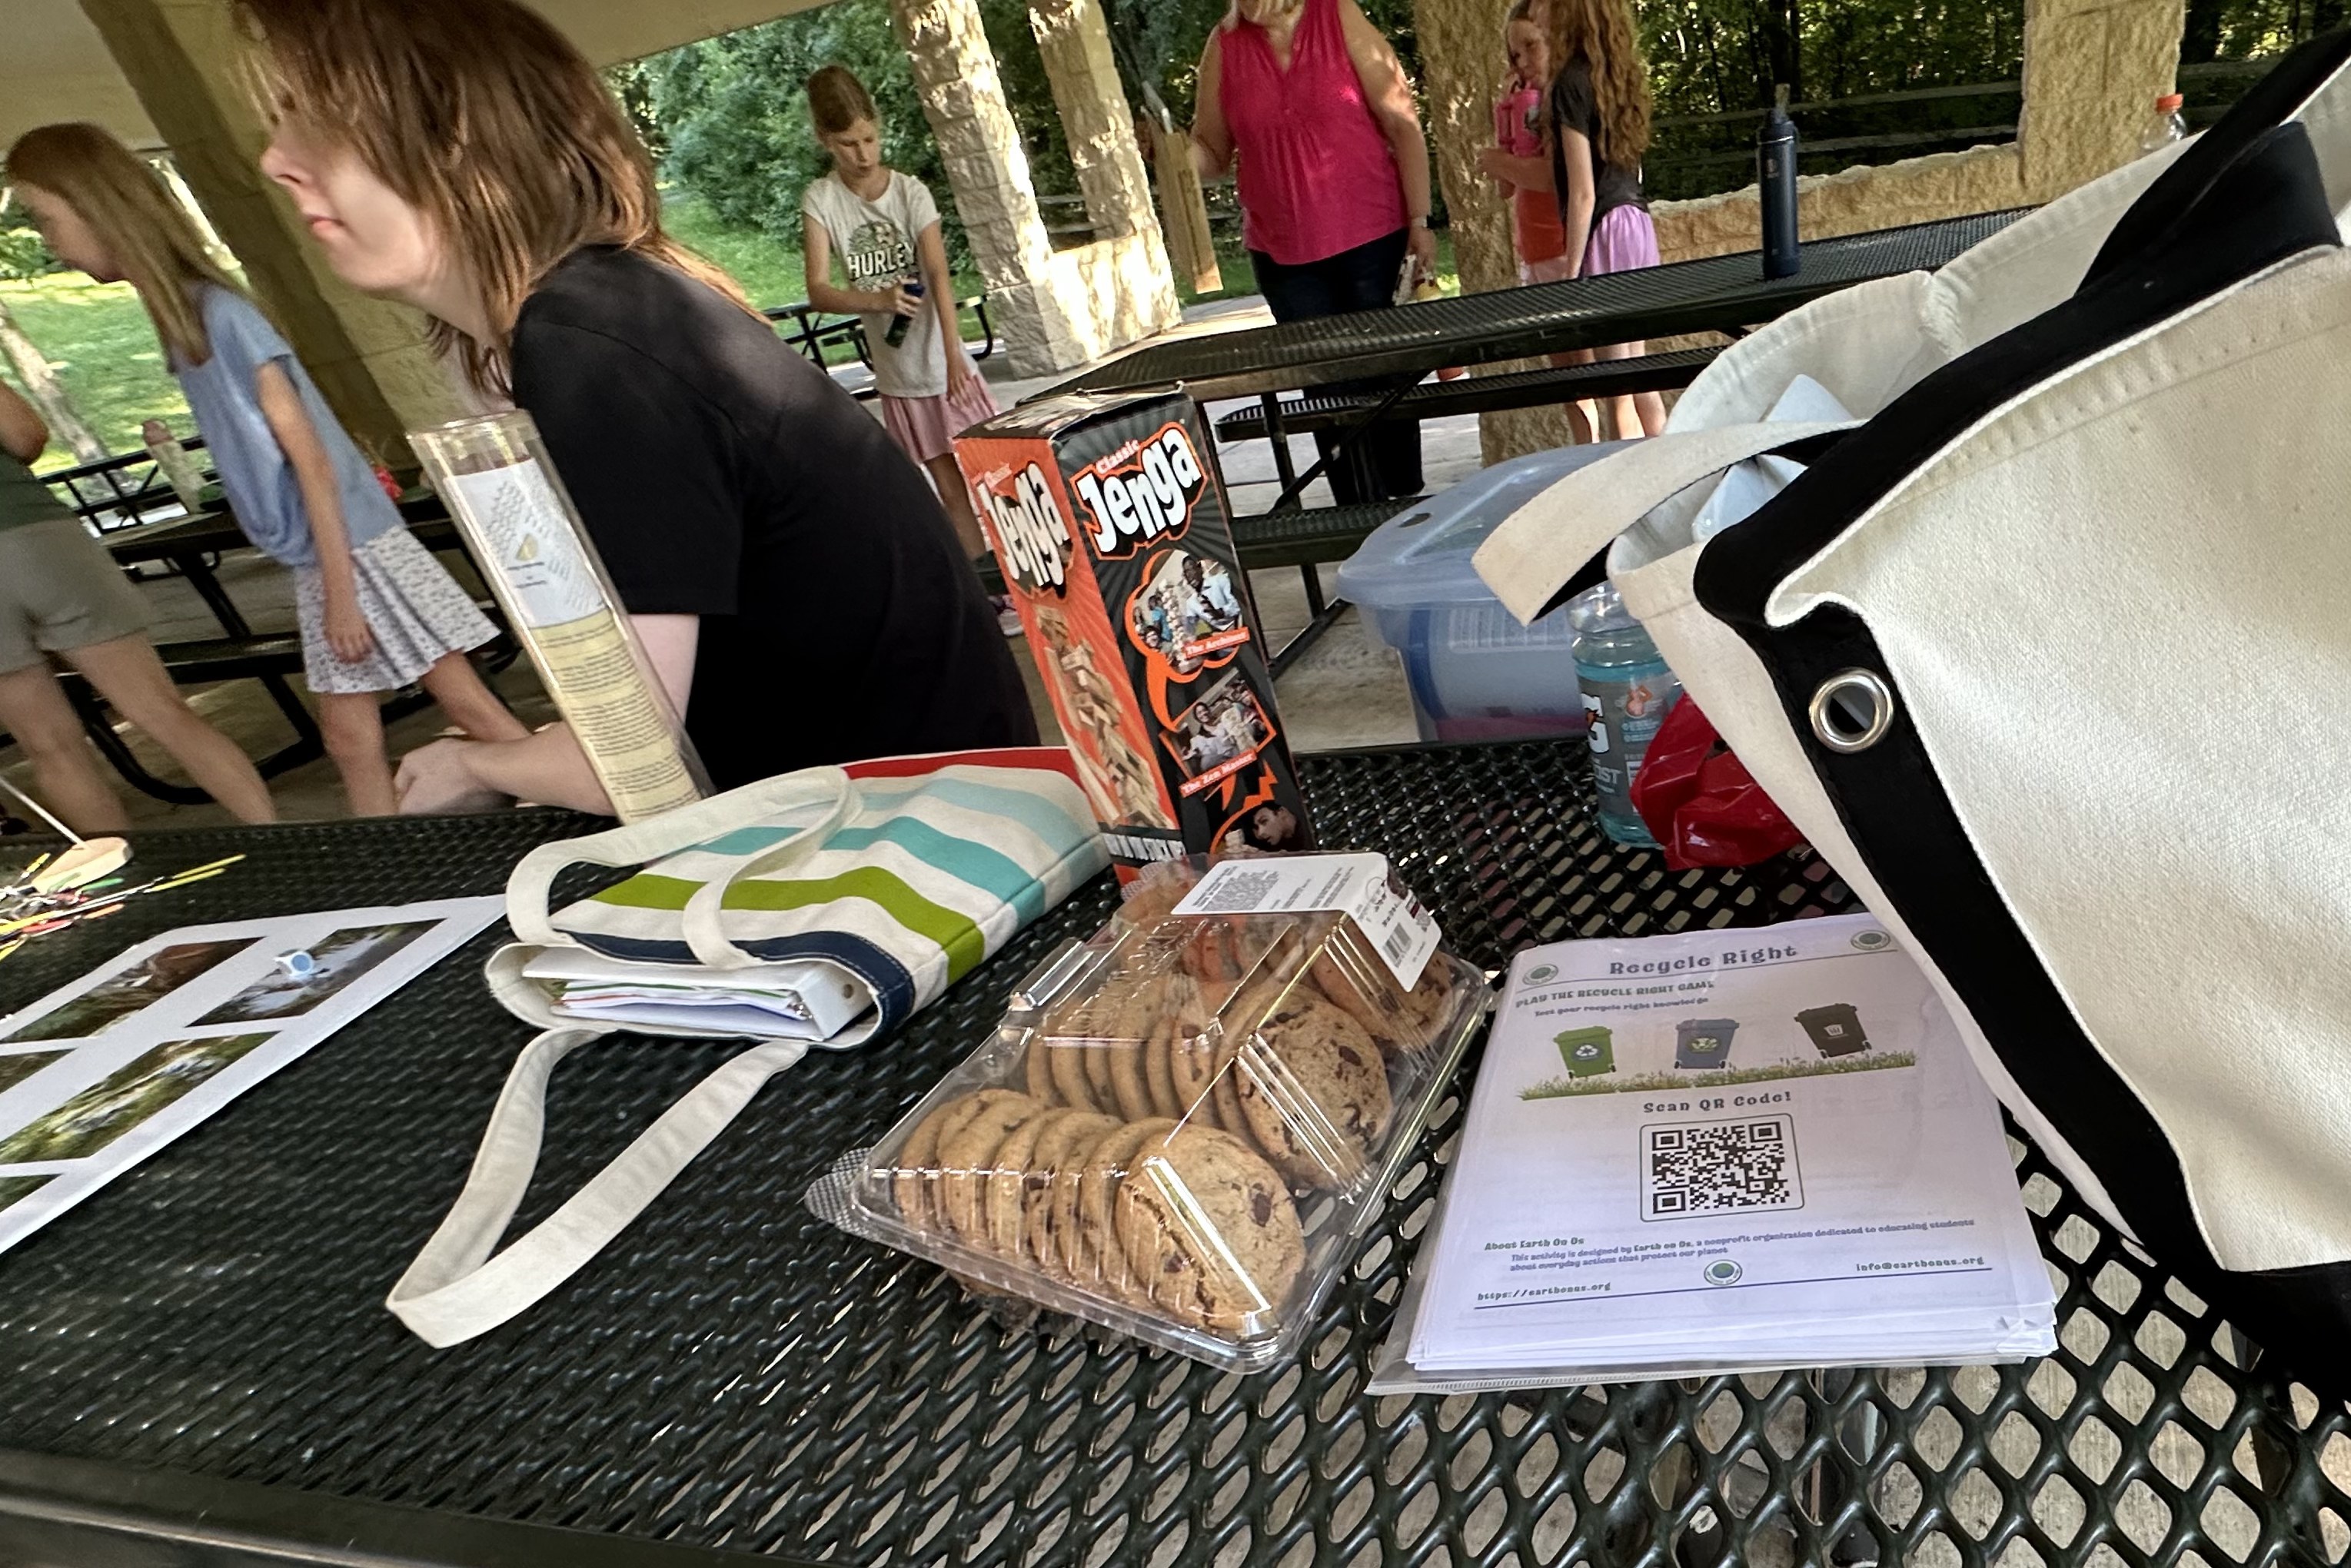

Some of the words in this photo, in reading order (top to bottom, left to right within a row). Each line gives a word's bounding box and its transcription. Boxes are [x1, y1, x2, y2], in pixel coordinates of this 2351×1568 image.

[846, 241, 916, 279] HURLEY
[1096, 440, 1140, 474] Classic
[1076, 428, 1202, 553] Jenga
[976, 463, 1071, 586] Jenga
[1609, 955, 1711, 975] Recycle
[1722, 945, 1798, 965] Right
[1551, 990, 1574, 999] THE
[1578, 987, 1632, 998] RECYCLE
[1636, 985, 1674, 995] RIGHT
[1557, 1006, 1581, 1015] your
[1584, 1004, 1621, 1012] recycle
[1623, 1002, 1650, 1011] right
[1643, 1102, 1690, 1113] Scan
[1699, 1098, 1724, 1111] QR
[1734, 1091, 1791, 1107] Code!
[1485, 1241, 1518, 1251] About
[1520, 1238, 1551, 1247] Earth
[1553, 1237, 1568, 1246] On
[1511, 1254, 1529, 1262] This
[1531, 1251, 1566, 1261] activity
[1568, 1250, 1576, 1258] is
[1578, 1246, 1618, 1257] designed
[1621, 1245, 1632, 1254] by
[1634, 1243, 1661, 1252] Earth
[1704, 1235, 1751, 1246] nonprofit
[1753, 1230, 1813, 1242] organization
[1814, 1226, 1864, 1237] dedicated
[1878, 1221, 1928, 1232] educating
[1930, 1219, 1975, 1229] students
[1510, 1263, 1537, 1271] about
[1538, 1260, 1581, 1270] everyday
[1582, 1257, 1617, 1267] actions
[1618, 1254, 1639, 1263] that
[1641, 1250, 1677, 1261] protect
[1698, 1247, 1728, 1257] planet
